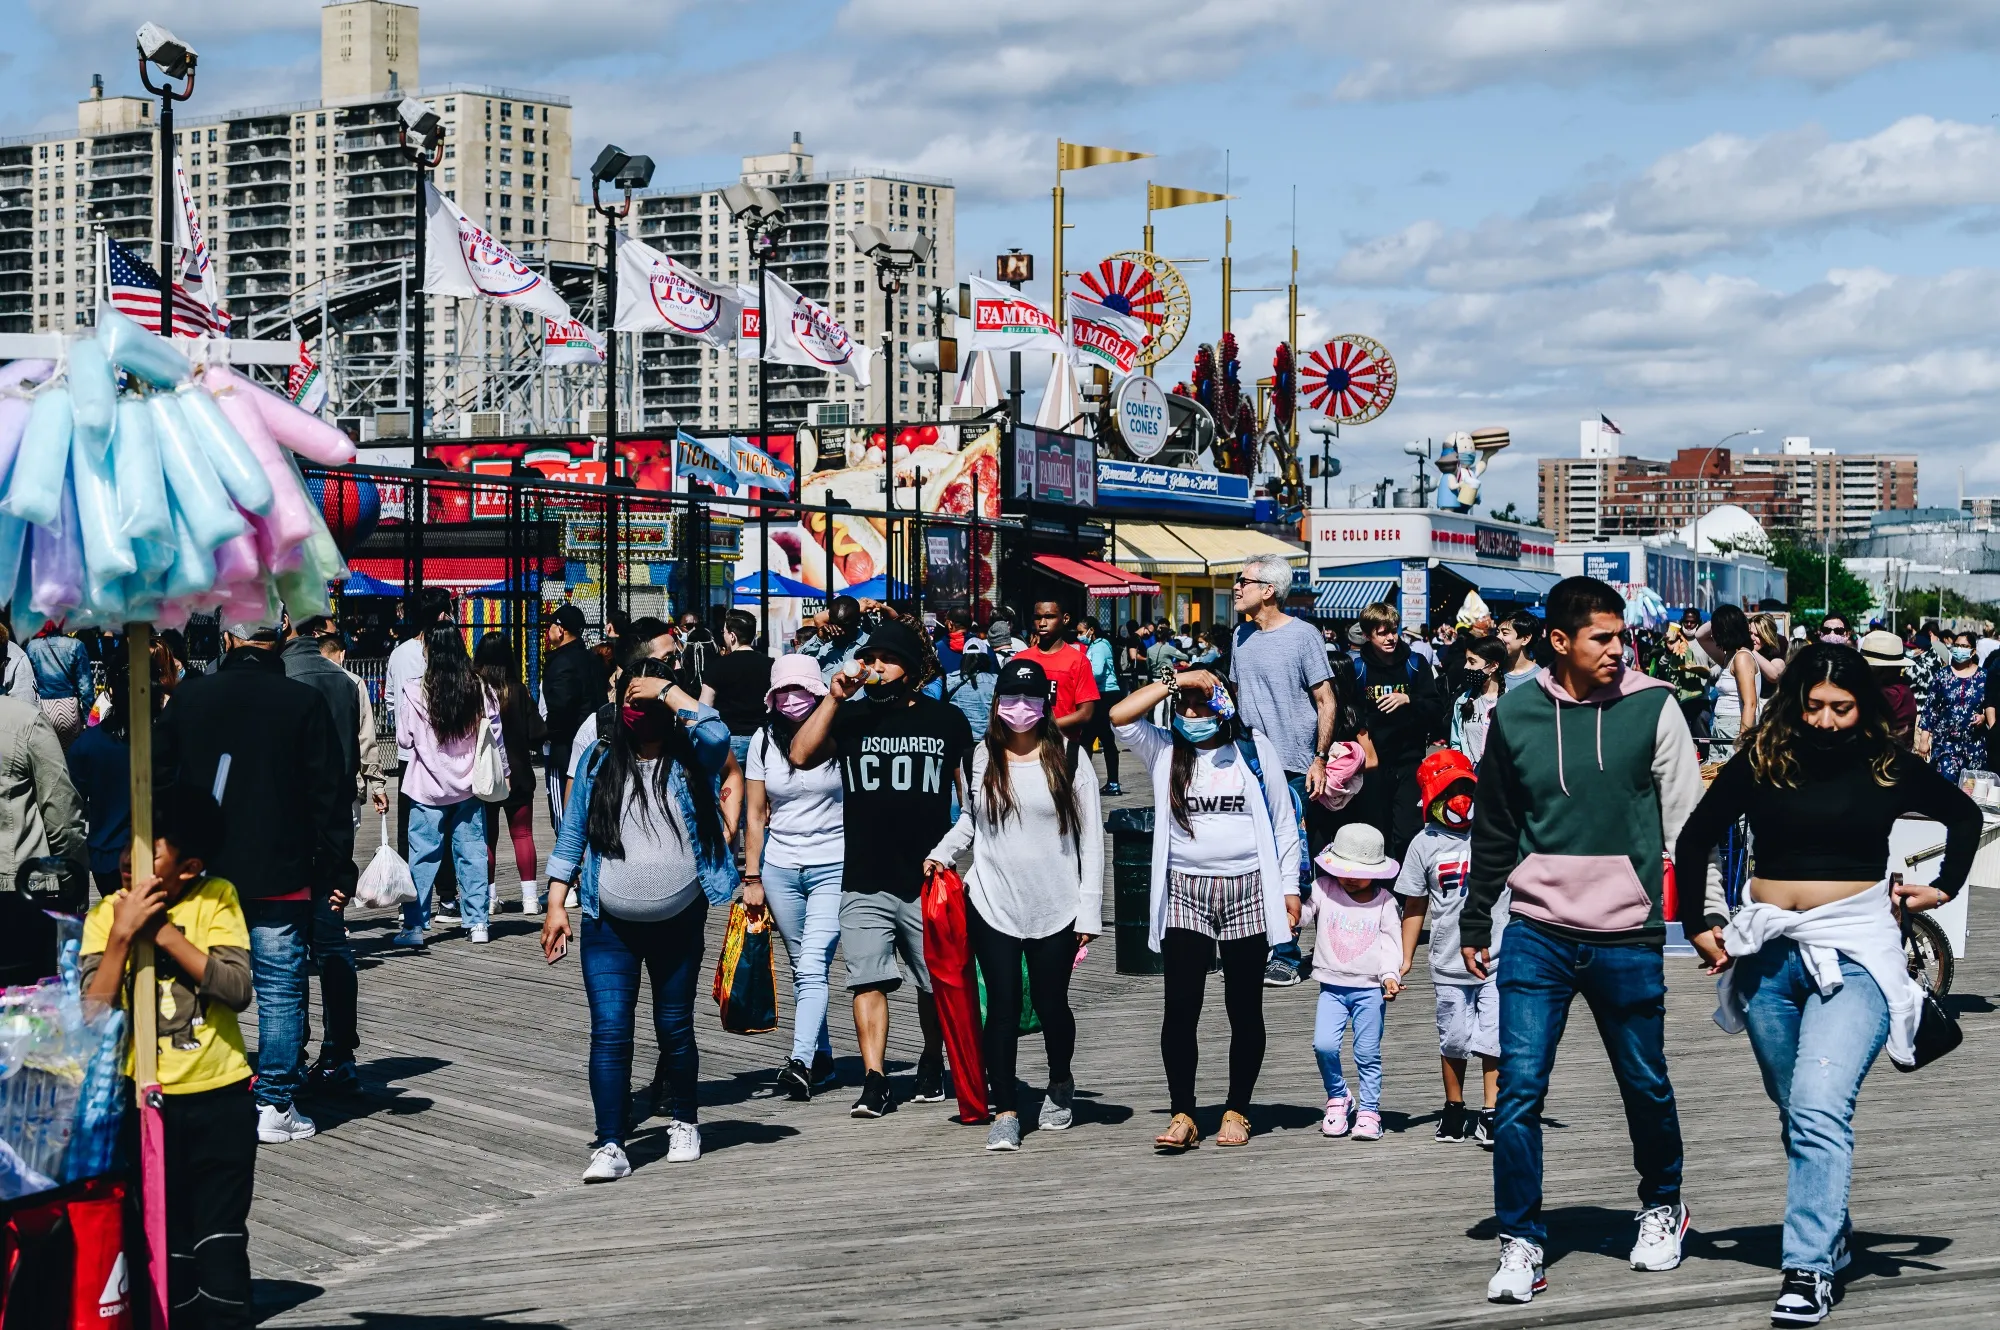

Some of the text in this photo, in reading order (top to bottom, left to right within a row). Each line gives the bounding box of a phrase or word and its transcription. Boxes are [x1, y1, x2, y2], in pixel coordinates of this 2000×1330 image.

[650, 273, 686, 288] WONDER
[1126, 401, 1162, 420] CONEY'S
[1130, 418, 1158, 436] CONES
[1017, 448, 1034, 466] SNACK
[1020, 464, 1031, 481] BAR
[1040, 460, 1072, 488] FAMIGLIA
[1076, 458, 1092, 475] SNACK
[1079, 473, 1089, 490] BAR
[1097, 464, 1138, 483] Homemade
[1169, 474, 1191, 491] Gelato
[1195, 476, 1218, 491] Sorbet
[1320, 529, 1401, 541] ICE COLD BEER
[1587, 562, 1619, 570] STRAIGHT
[861, 736, 945, 757] DSQUARED2
[846, 754, 944, 794] ICON
[1186, 795, 1246, 813] OWER
